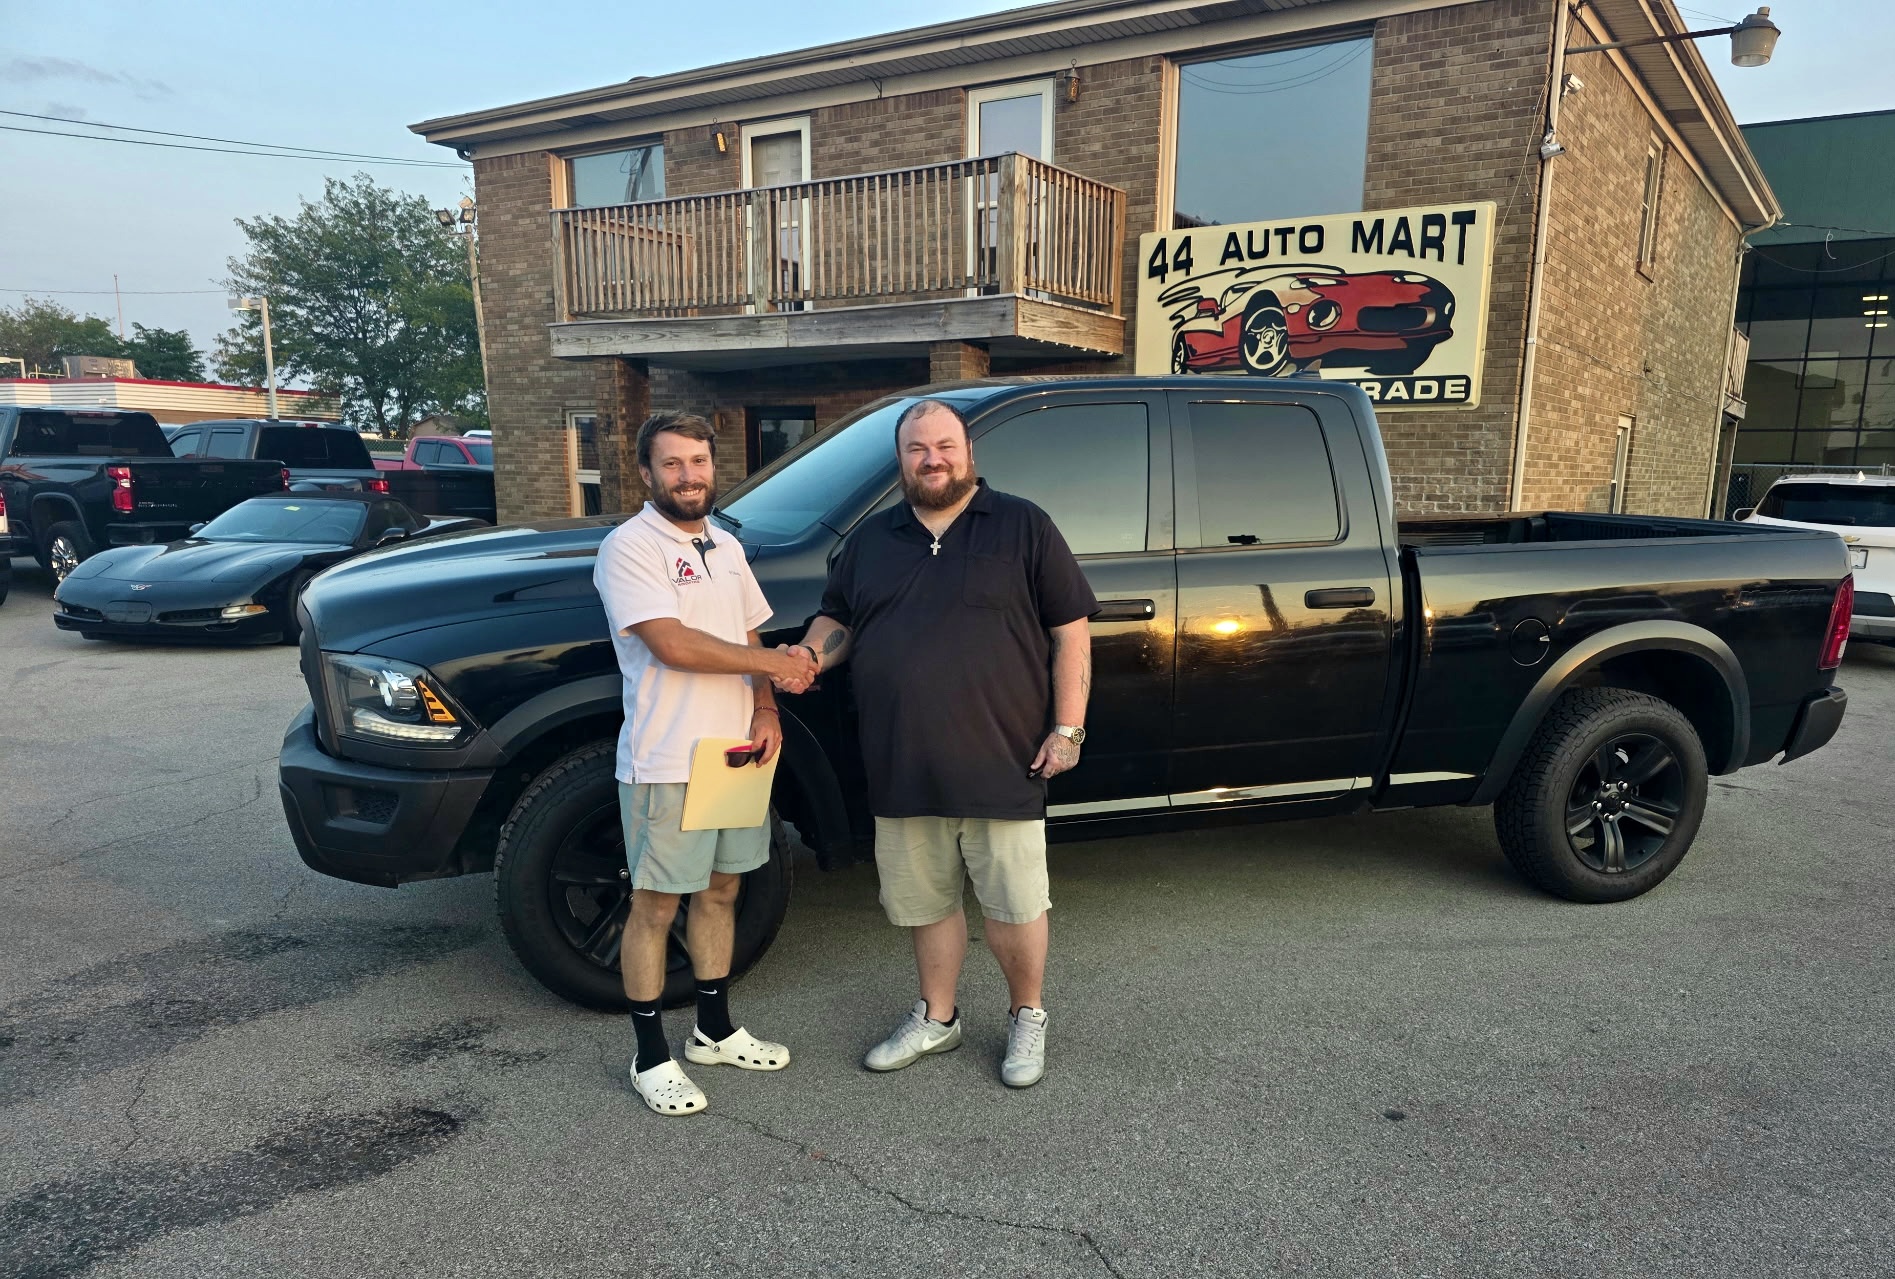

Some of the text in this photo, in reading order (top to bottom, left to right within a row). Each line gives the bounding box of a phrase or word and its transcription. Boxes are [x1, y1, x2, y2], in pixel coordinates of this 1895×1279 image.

[1148, 209, 1477, 284] 44 AUTO MART
[1348, 378, 1467, 401] RADE
[671, 574, 703, 584] VALOR
